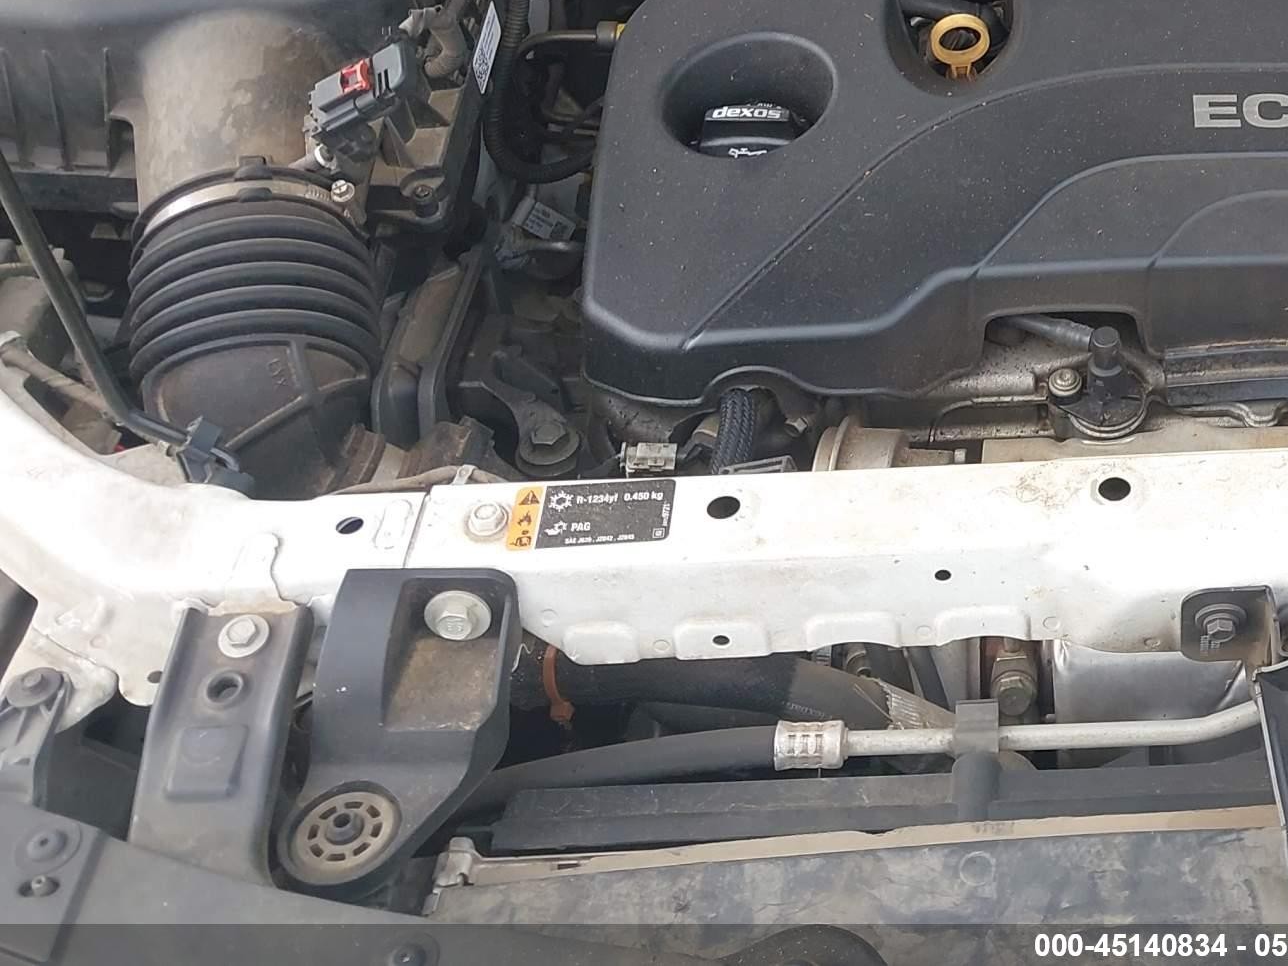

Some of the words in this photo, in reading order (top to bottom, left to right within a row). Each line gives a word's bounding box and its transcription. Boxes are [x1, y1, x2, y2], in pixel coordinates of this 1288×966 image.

[711, 106, 782, 119] dexos
[576, 492, 619, 505] R-1234yf
[623, 491, 650, 501] 0.450
[651, 490, 664, 502] kg
[570, 522, 591, 532] PAG
